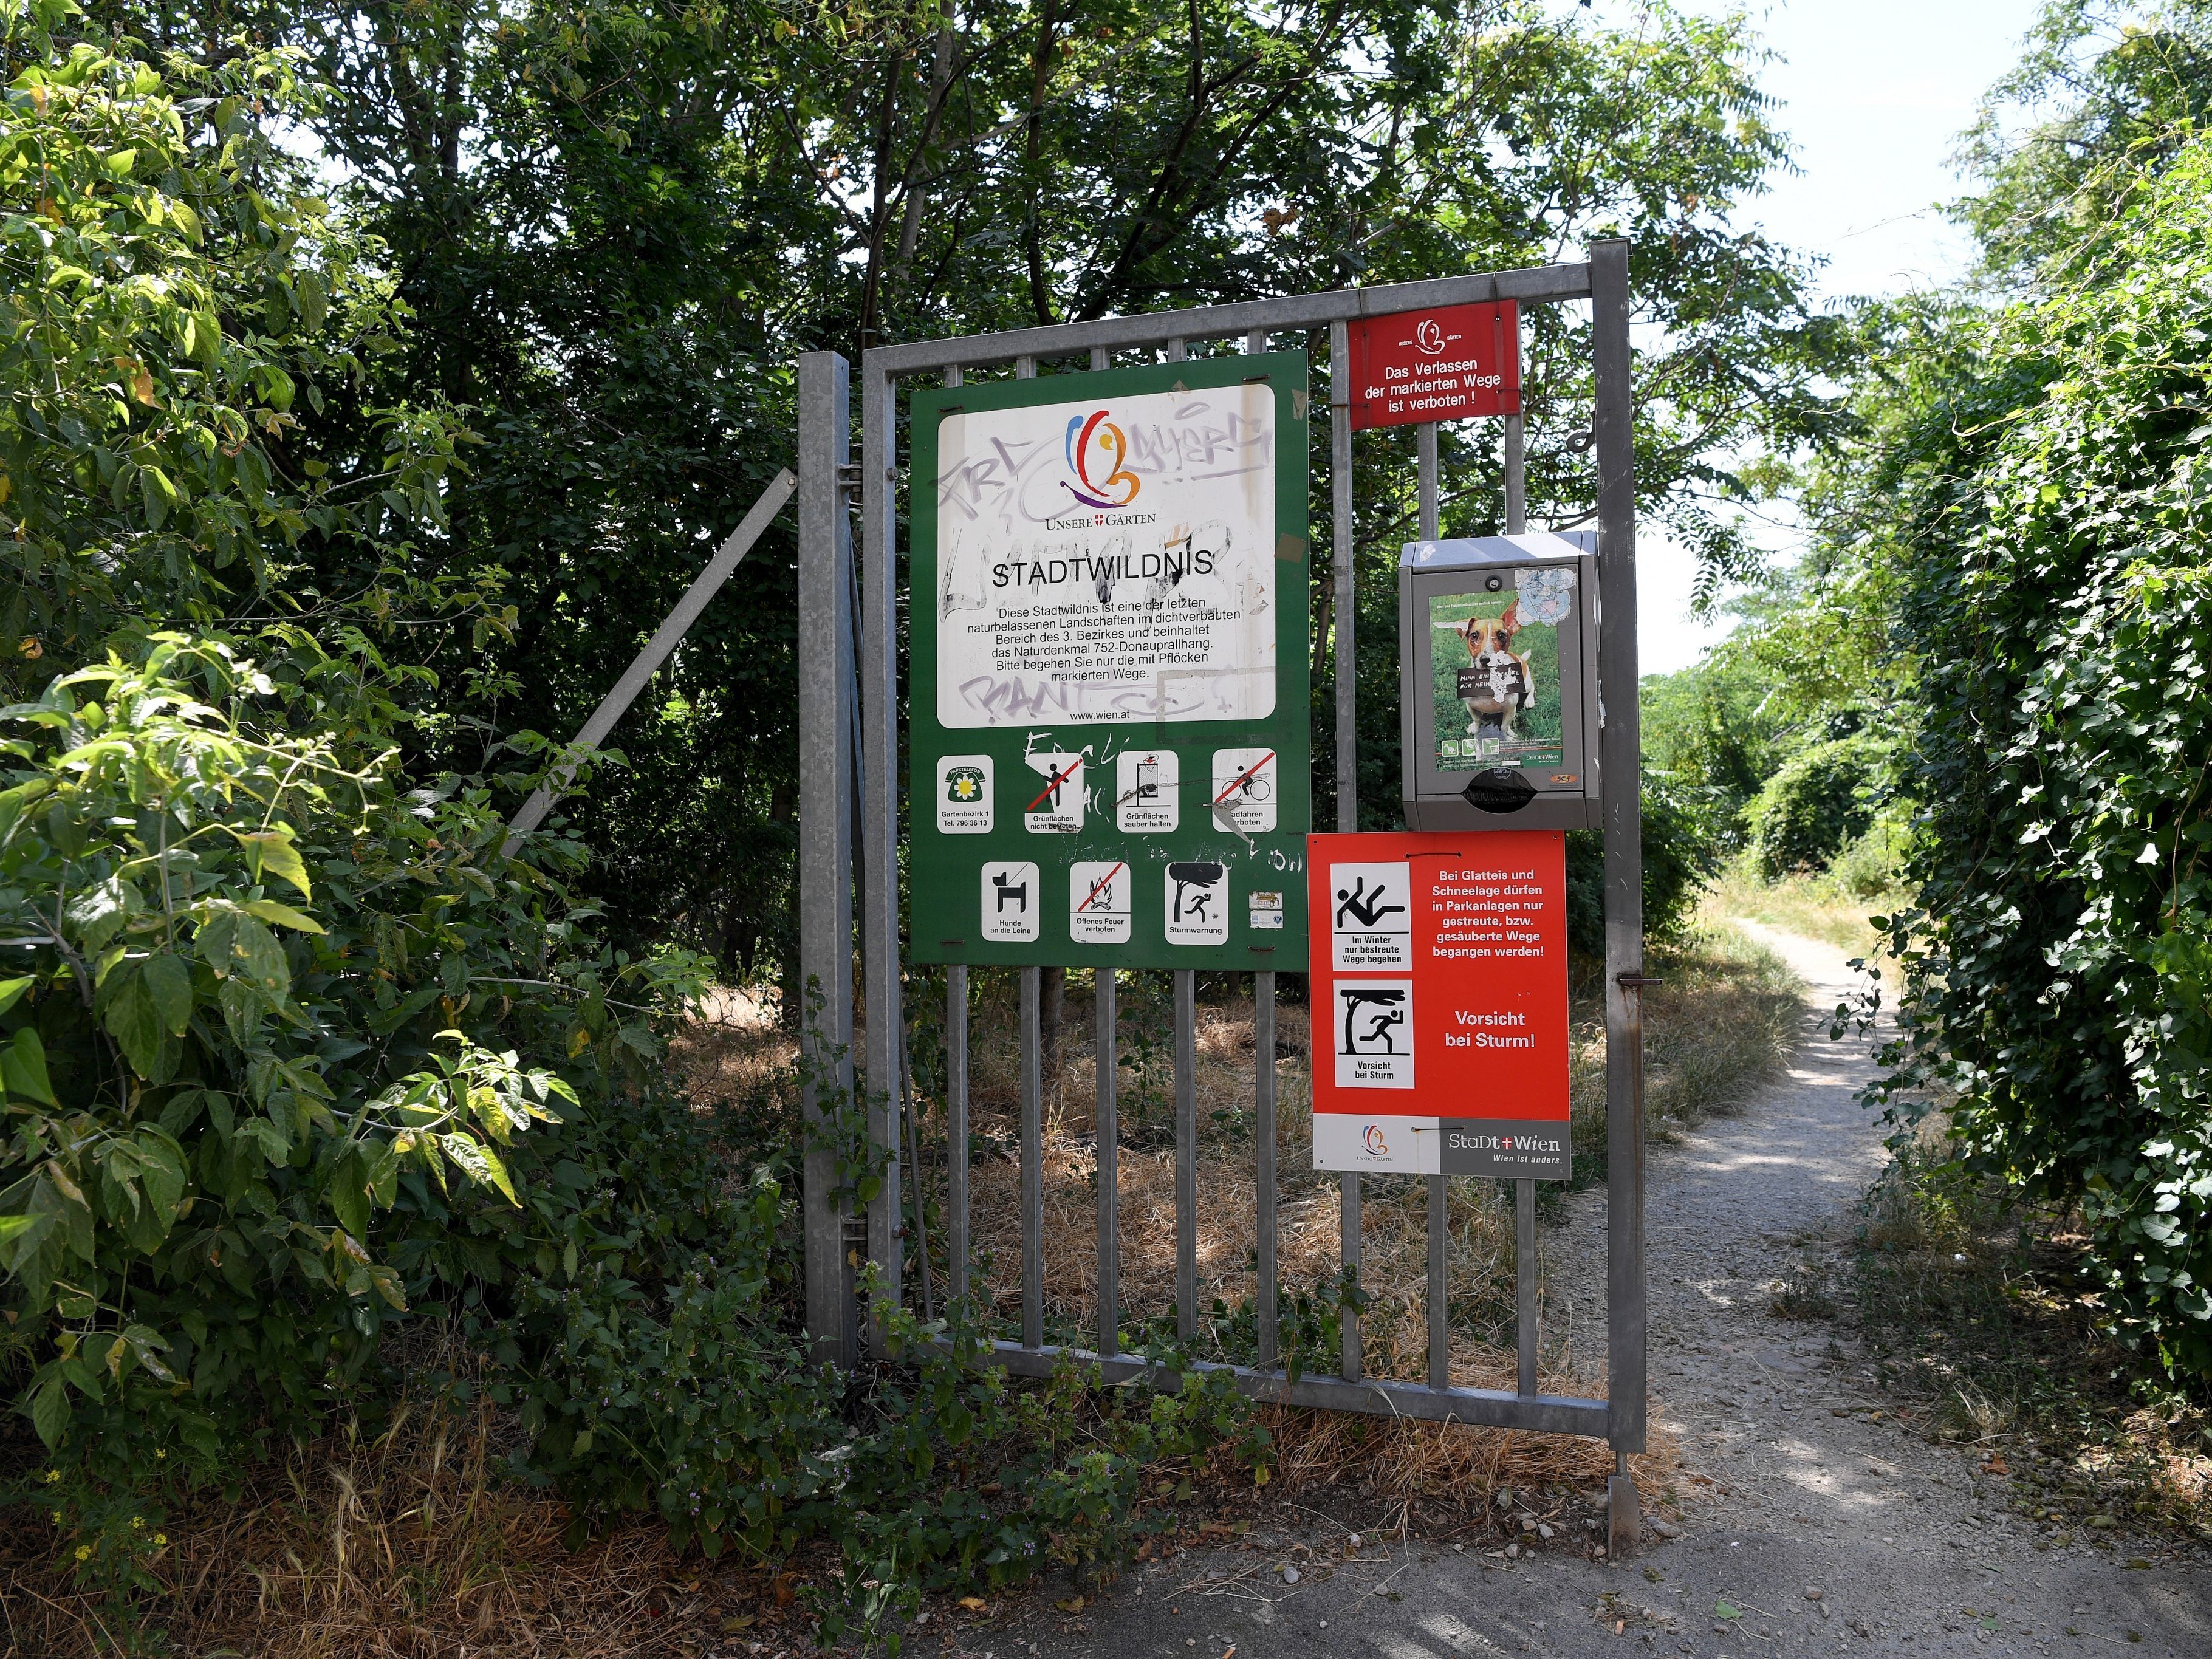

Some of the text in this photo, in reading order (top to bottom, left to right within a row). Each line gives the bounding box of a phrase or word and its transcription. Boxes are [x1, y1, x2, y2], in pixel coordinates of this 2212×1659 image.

[1385, 360, 1478, 380] Das Verlassen
[1365, 374, 1501, 399] der markierten Wege
[1389, 391, 1475, 413] ist verboten !
[1046, 513, 1156, 531] UNSERE GÄRTEN
[992, 550, 1213, 587] STADTWILDNIS
[999, 598, 1205, 618] Diese Stadtwildnis ist eine der letzten
[967, 609, 1241, 634] naturbelassenen Landschaften im dichtverbauten
[996, 624, 1210, 645] Bereich des 3. Bezirkes und beinhaltet
[991, 639, 1213, 658] das Naturdenkmal 752-Donauprallhang.
[996, 652, 1208, 671] Bitte begehen Sie nur die mit Pflöcken
[1051, 668, 1149, 682] markierten Wege.
[1070, 710, 1130, 720] www.wien.at
[1439, 869, 1534, 881] Bei Glatteis und
[1432, 884, 1543, 897] Schneelage dürfen
[1432, 901, 1443, 911] in
[1447, 900, 1520, 912] Parkanlagen
[1442, 915, 1533, 928] gestreute, bzw.
[1169, 926, 1222, 936] Sturmwarnung
[1437, 931, 1540, 943] gesäuberte Wege
[1365, 936, 1391, 944] Winter
[1343, 954, 1402, 965] Wege begehen
[1433, 946, 1544, 959] begangen werden!
[1455, 1011, 1525, 1026] Vorsicht
[1445, 1032, 1535, 1048] bei Sturm!
[1357, 1061, 1391, 1070] Vorsicht
[1355, 1070, 1394, 1079] bei Sturm
[1513, 1134, 1561, 1152] Wien
[1531, 1156, 1563, 1165] anders.
